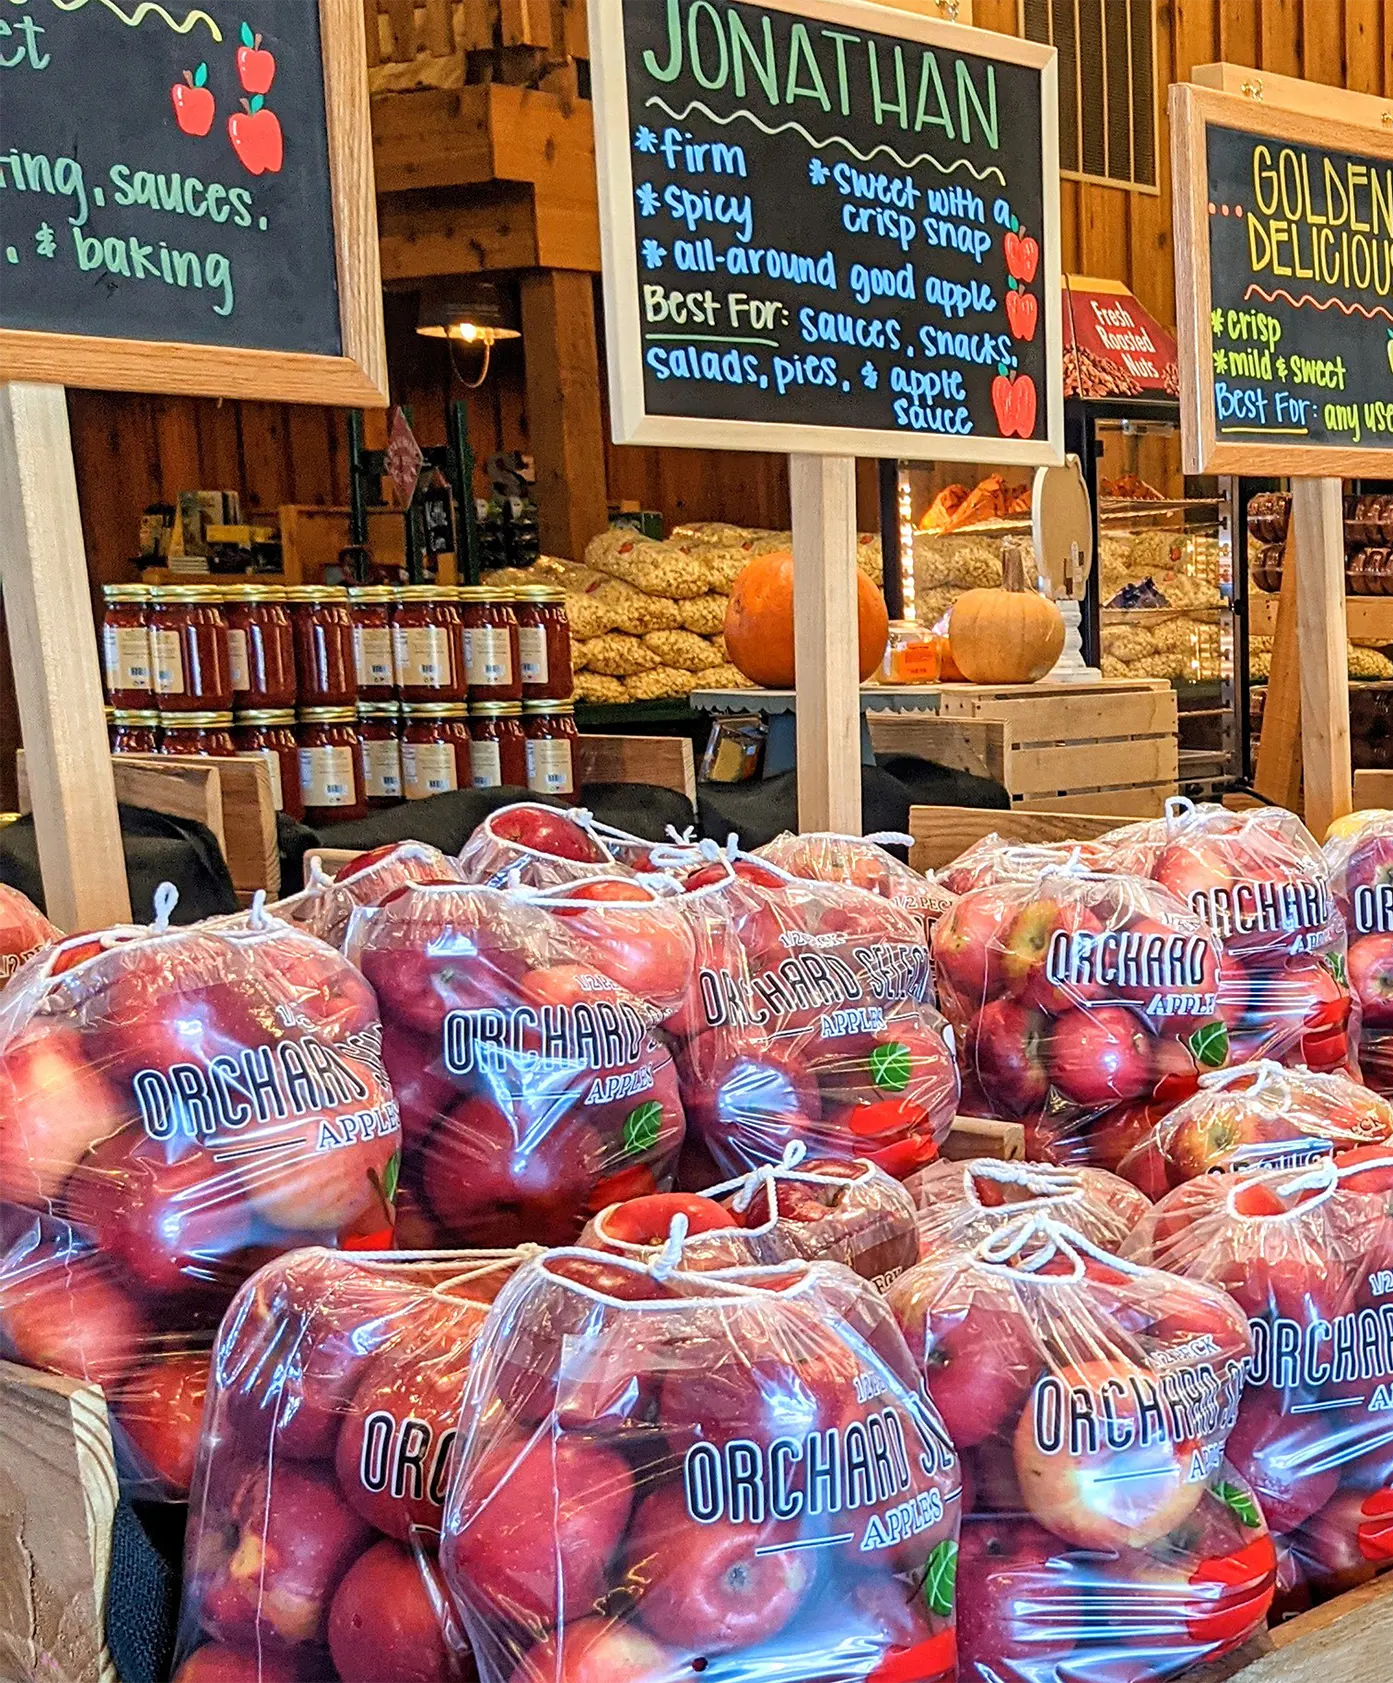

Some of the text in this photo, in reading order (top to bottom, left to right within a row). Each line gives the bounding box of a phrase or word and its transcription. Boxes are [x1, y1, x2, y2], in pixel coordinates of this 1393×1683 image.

[643, 0, 999, 150] JONATHAN
[659, 127, 748, 178] firm
[664, 189, 754, 243] spicy
[832, 163, 1012, 230] sweet with a
[842, 203, 992, 263] crisp snap
[72, 227, 234, 316] baking
[673, 243, 997, 318] all-around good apple
[644, 285, 790, 330] Best For:
[1090, 300, 1135, 329] Fresh
[1227, 309, 1282, 353] crisp
[1095, 324, 1157, 353] Roasted
[1120, 352, 1160, 379] Nuts
[890, 367, 966, 405] apple
[1229, 349, 1273, 381] mild
[1291, 356, 1347, 390] sweet
[896, 399, 974, 436] sauce
[1215, 383, 1268, 425] Best
[1275, 392, 1318, 426] For:
[1324, 403, 1360, 442] any
[1187, 874, 1333, 940] ORCHARD
[1047, 929, 1208, 988] ORCHARD
[445, 1002, 647, 1075] ORCHARD
[1034, 1362, 1222, 1456] ORCHARD
[684, 1406, 912, 1525] ORCHARD
[860, 1487, 944, 1551] APPLES
